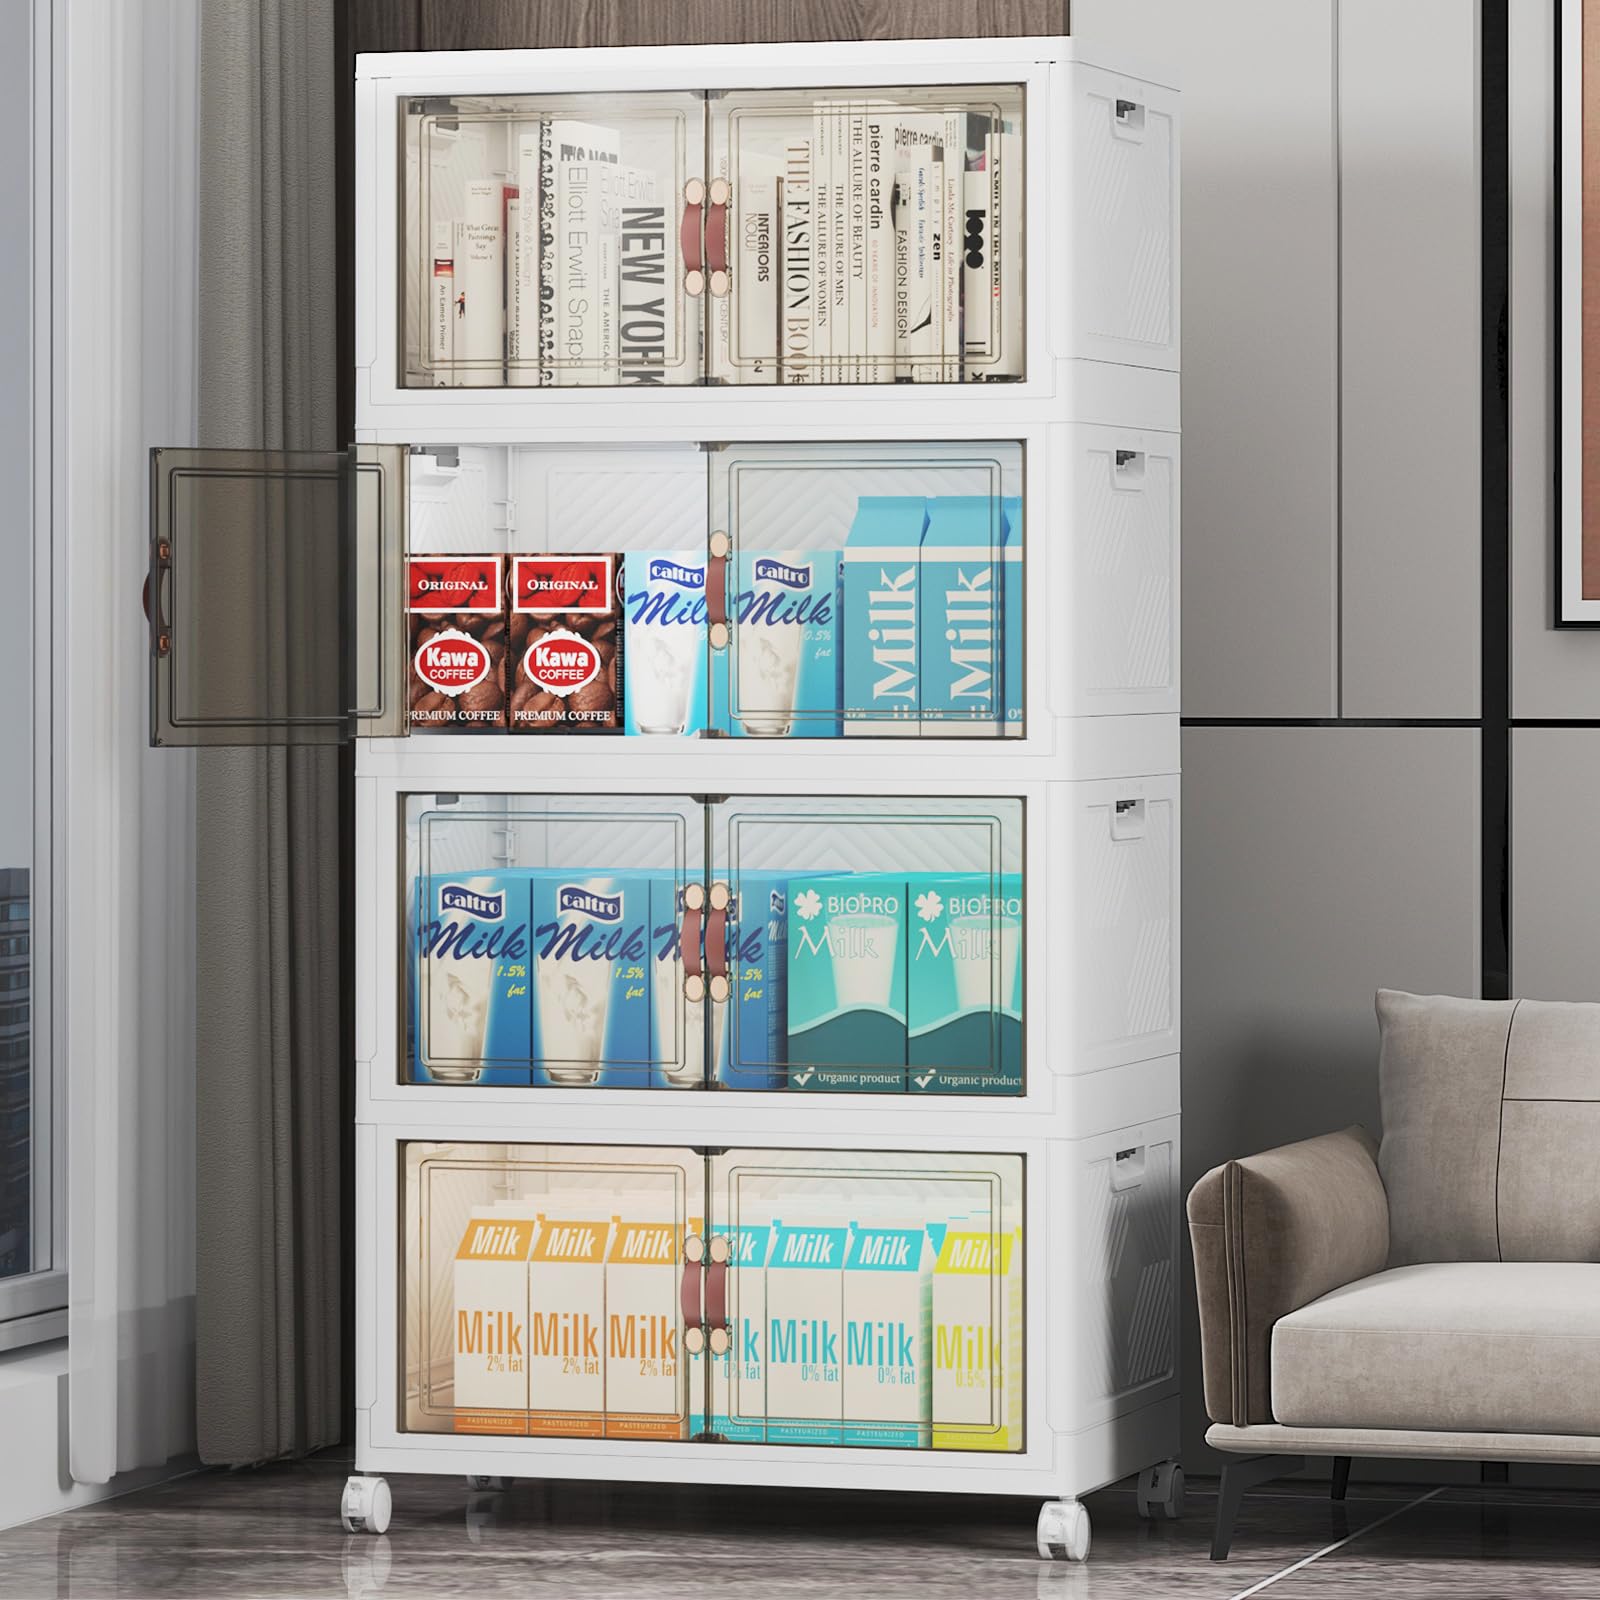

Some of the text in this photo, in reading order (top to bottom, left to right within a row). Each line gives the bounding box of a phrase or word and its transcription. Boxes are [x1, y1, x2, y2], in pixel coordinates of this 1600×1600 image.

[894, 122, 918, 150] pierre
[787, 140, 810, 194] THE
[868, 124, 884, 230] pierre cardin
[568, 167, 589, 224] Elliott
[852, 117, 863, 280] THE ALLURE OF BEAUTY
[621, 207, 665, 285] NEW
[757, 213, 769, 282] INTERIORS
[787, 200, 810, 310] FASHION
[817, 184, 827, 327] THE ALLURE OF WOMEN
[834, 184, 844, 306] THE ALLURE OF MEN
[933, 233, 941, 261] zen
[568, 231, 589, 289] Erwitt
[872, 272, 878, 283] OF
[897, 229, 908, 339] FASHION DESIGN
[439, 285, 446, 296] An
[651, 565, 704, 584] caltro
[757, 564, 808, 583] caltro
[417, 579, 489, 591] ORIGINAL
[526, 579, 599, 591] ORIGINAL
[627, 590, 709, 626] Mil
[733, 590, 833, 627] Milk
[805, 630, 832, 641] 0.5%
[868, 565, 916, 703] Milk
[945, 566, 992, 703] Milk
[427, 647, 479, 667] Kawa
[535, 647, 589, 667] Kawa
[429, 669, 475, 680] COFFEE
[538, 669, 585, 680] COFFEE
[409, 710, 501, 721] REMIUM COFFEE
[514, 710, 611, 721] PREMIUM COFFEE
[443, 892, 500, 914] caltro
[562, 894, 619, 916] caltro
[827, 896, 899, 914] BIOPRO
[949, 897, 1022, 916] BIOPRO
[417, 920, 527, 961] Milk
[535, 921, 646, 962] Milk
[794, 925, 879, 960] Milk
[915, 926, 1000, 961] Milk
[496, 965, 526, 977] 1.5%
[615, 967, 645, 979] 1.5%
[507, 985, 525, 997] fat
[625, 985, 645, 999] fat
[744, 987, 763, 1001] fat
[818, 1072, 900, 1089] Organic product
[939, 1074, 979, 1090] Organic
[470, 1225, 521, 1256] Milk
[545, 1227, 596, 1257] Milk
[621, 1229, 673, 1259] Milk
[783, 1232, 834, 1263] Milk
[859, 1235, 911, 1266] Milk
[458, 1310, 522, 1355] Milk
[533, 1312, 599, 1357] Milk
[610, 1314, 677, 1360] Milk
[771, 1319, 838, 1365] Milk
[847, 1321, 915, 1367] Milk
[487, 1355, 523, 1373] 2% fat
[562, 1358, 599, 1375] 2% fat
[640, 1359, 658, 1376] 2%
[745, 1364, 760, 1380] fat
[801, 1365, 839, 1382] 0% fat
[878, 1367, 915, 1385] 0% fat
[467, 1418, 513, 1426] PASTEURIZED
[543, 1420, 589, 1428] PASTEURIZED
[619, 1422, 667, 1430] PASTEURIZED
[780, 1428, 828, 1436] PASTEURIZED
